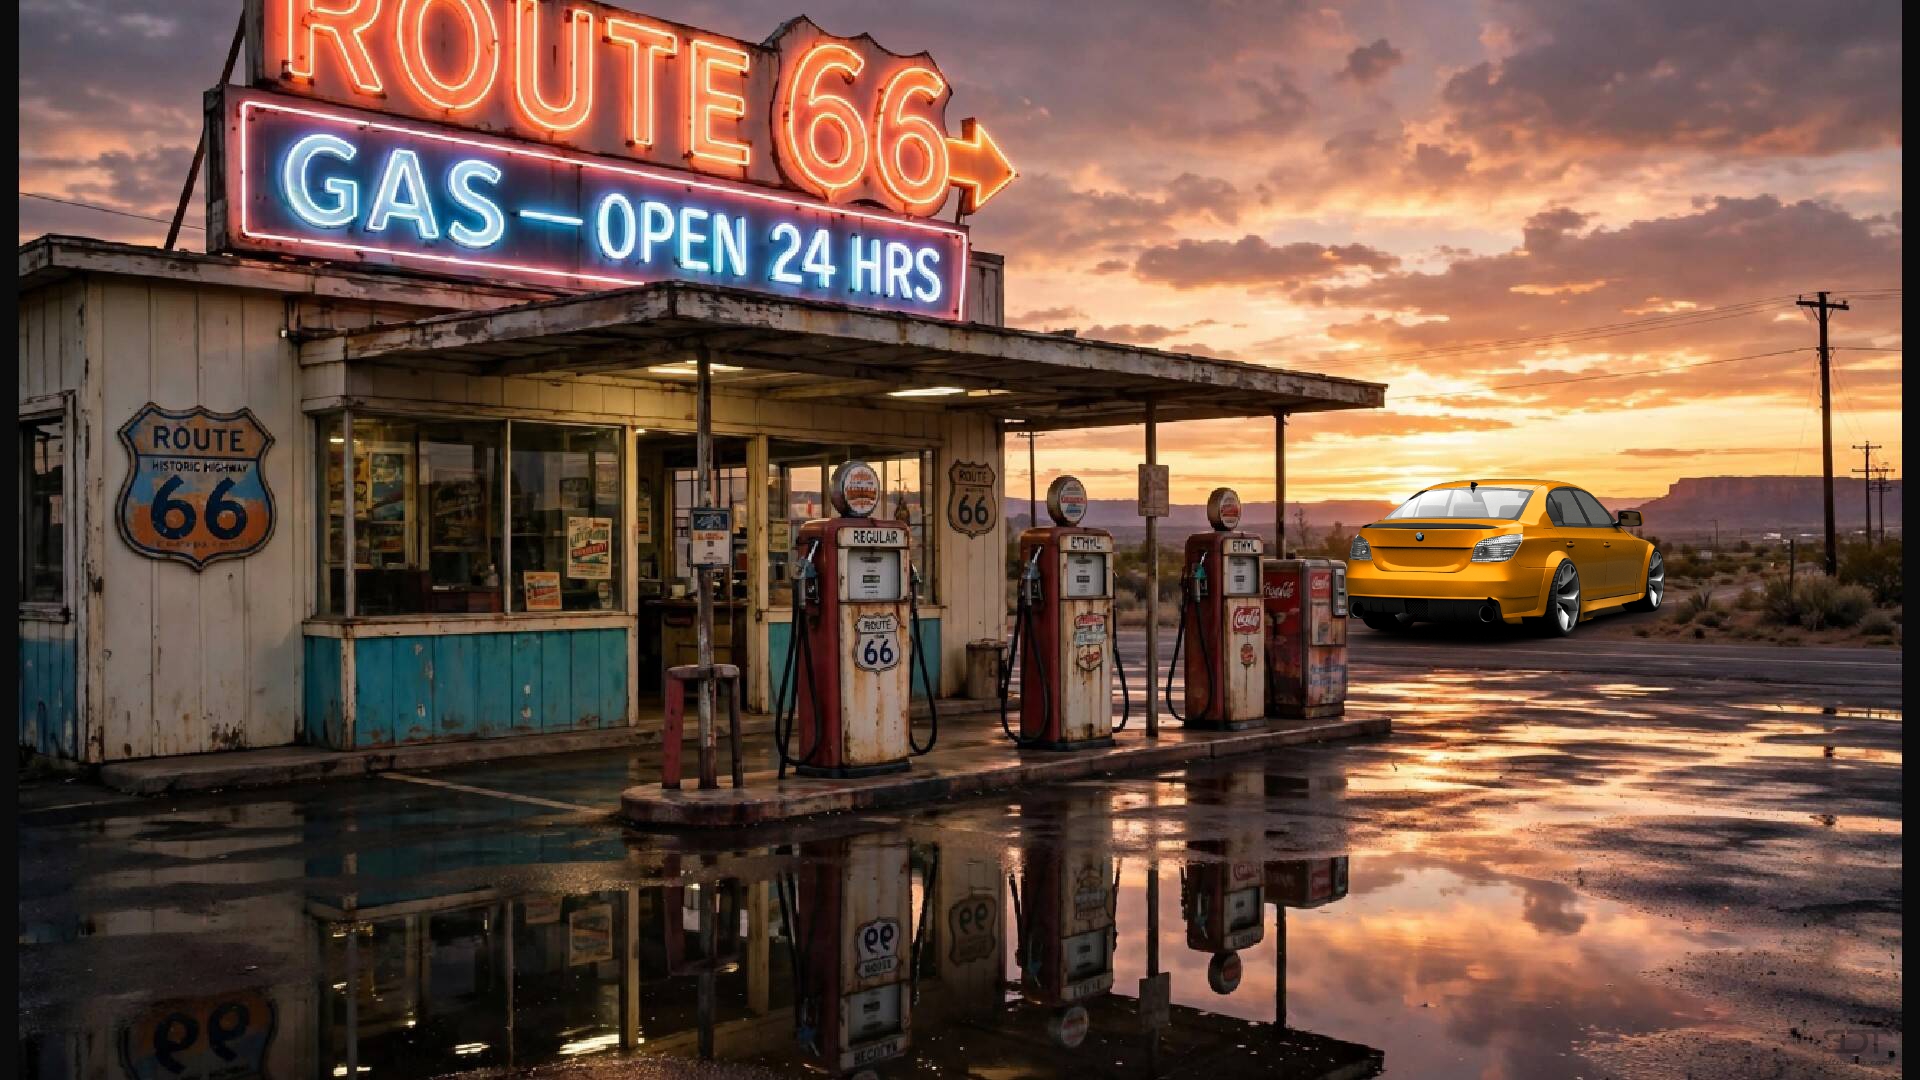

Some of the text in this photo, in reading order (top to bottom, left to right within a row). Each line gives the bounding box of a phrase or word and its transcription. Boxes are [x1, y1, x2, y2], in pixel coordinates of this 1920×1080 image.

[284, 0, 950, 208] ROUTE 66
[283, 134, 504, 248] GAS
[598, 192, 747, 278] OPEN
[769, 222, 836, 288] 24
[850, 234, 942, 302] HRS
[153, 426, 244, 451] ROUTE
[152, 460, 248, 474] HISTORIC HIGHWAY
[959, 471, 989, 483] ROUTE
[152, 475, 247, 539] 66
[958, 493, 989, 526] 66
[853, 531, 898, 544] REGULAR
[864, 621, 892, 631] ROUTE
[864, 639, 893, 665] 66
